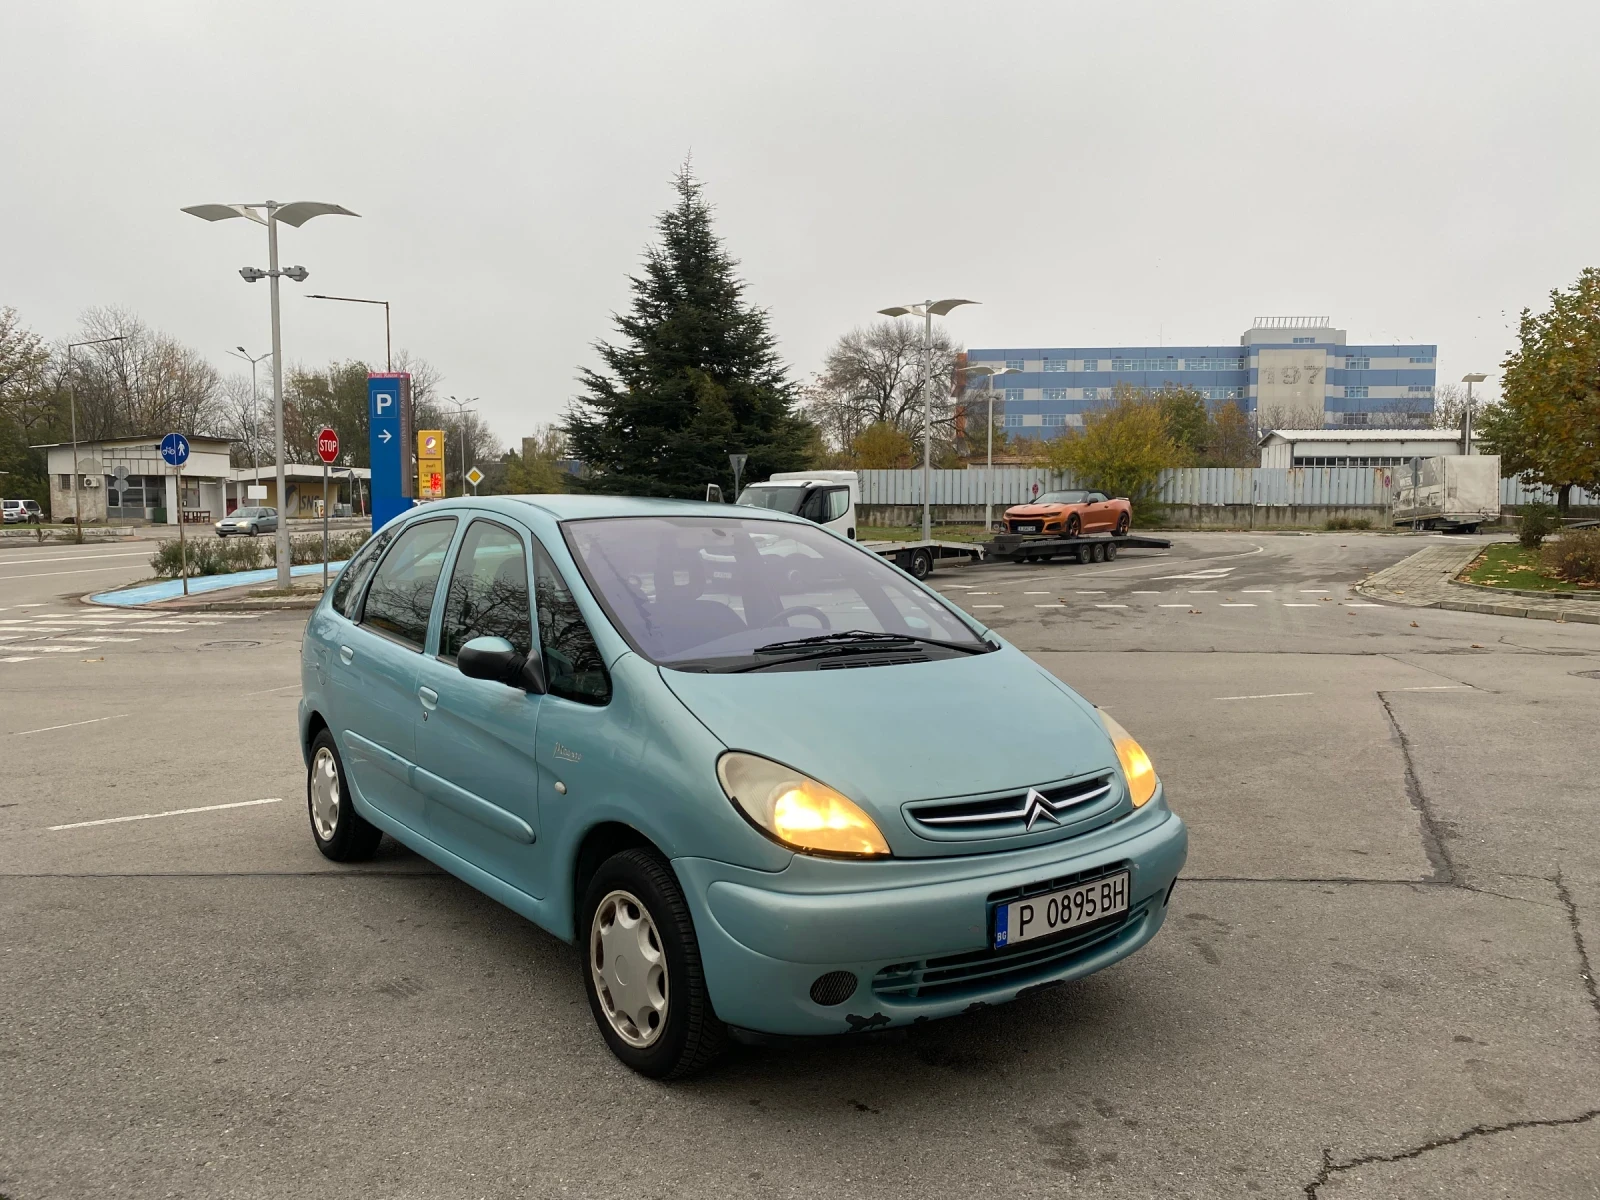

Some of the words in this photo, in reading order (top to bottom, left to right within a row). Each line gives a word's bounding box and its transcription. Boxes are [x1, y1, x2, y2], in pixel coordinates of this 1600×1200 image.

[1260, 365, 1324, 384] 197
[376, 393, 392, 415] P
[320, 440, 337, 452] STOP
[301, 496, 320, 510] SN
[1020, 904, 1034, 937] P
[997, 931, 1007, 941] BG
